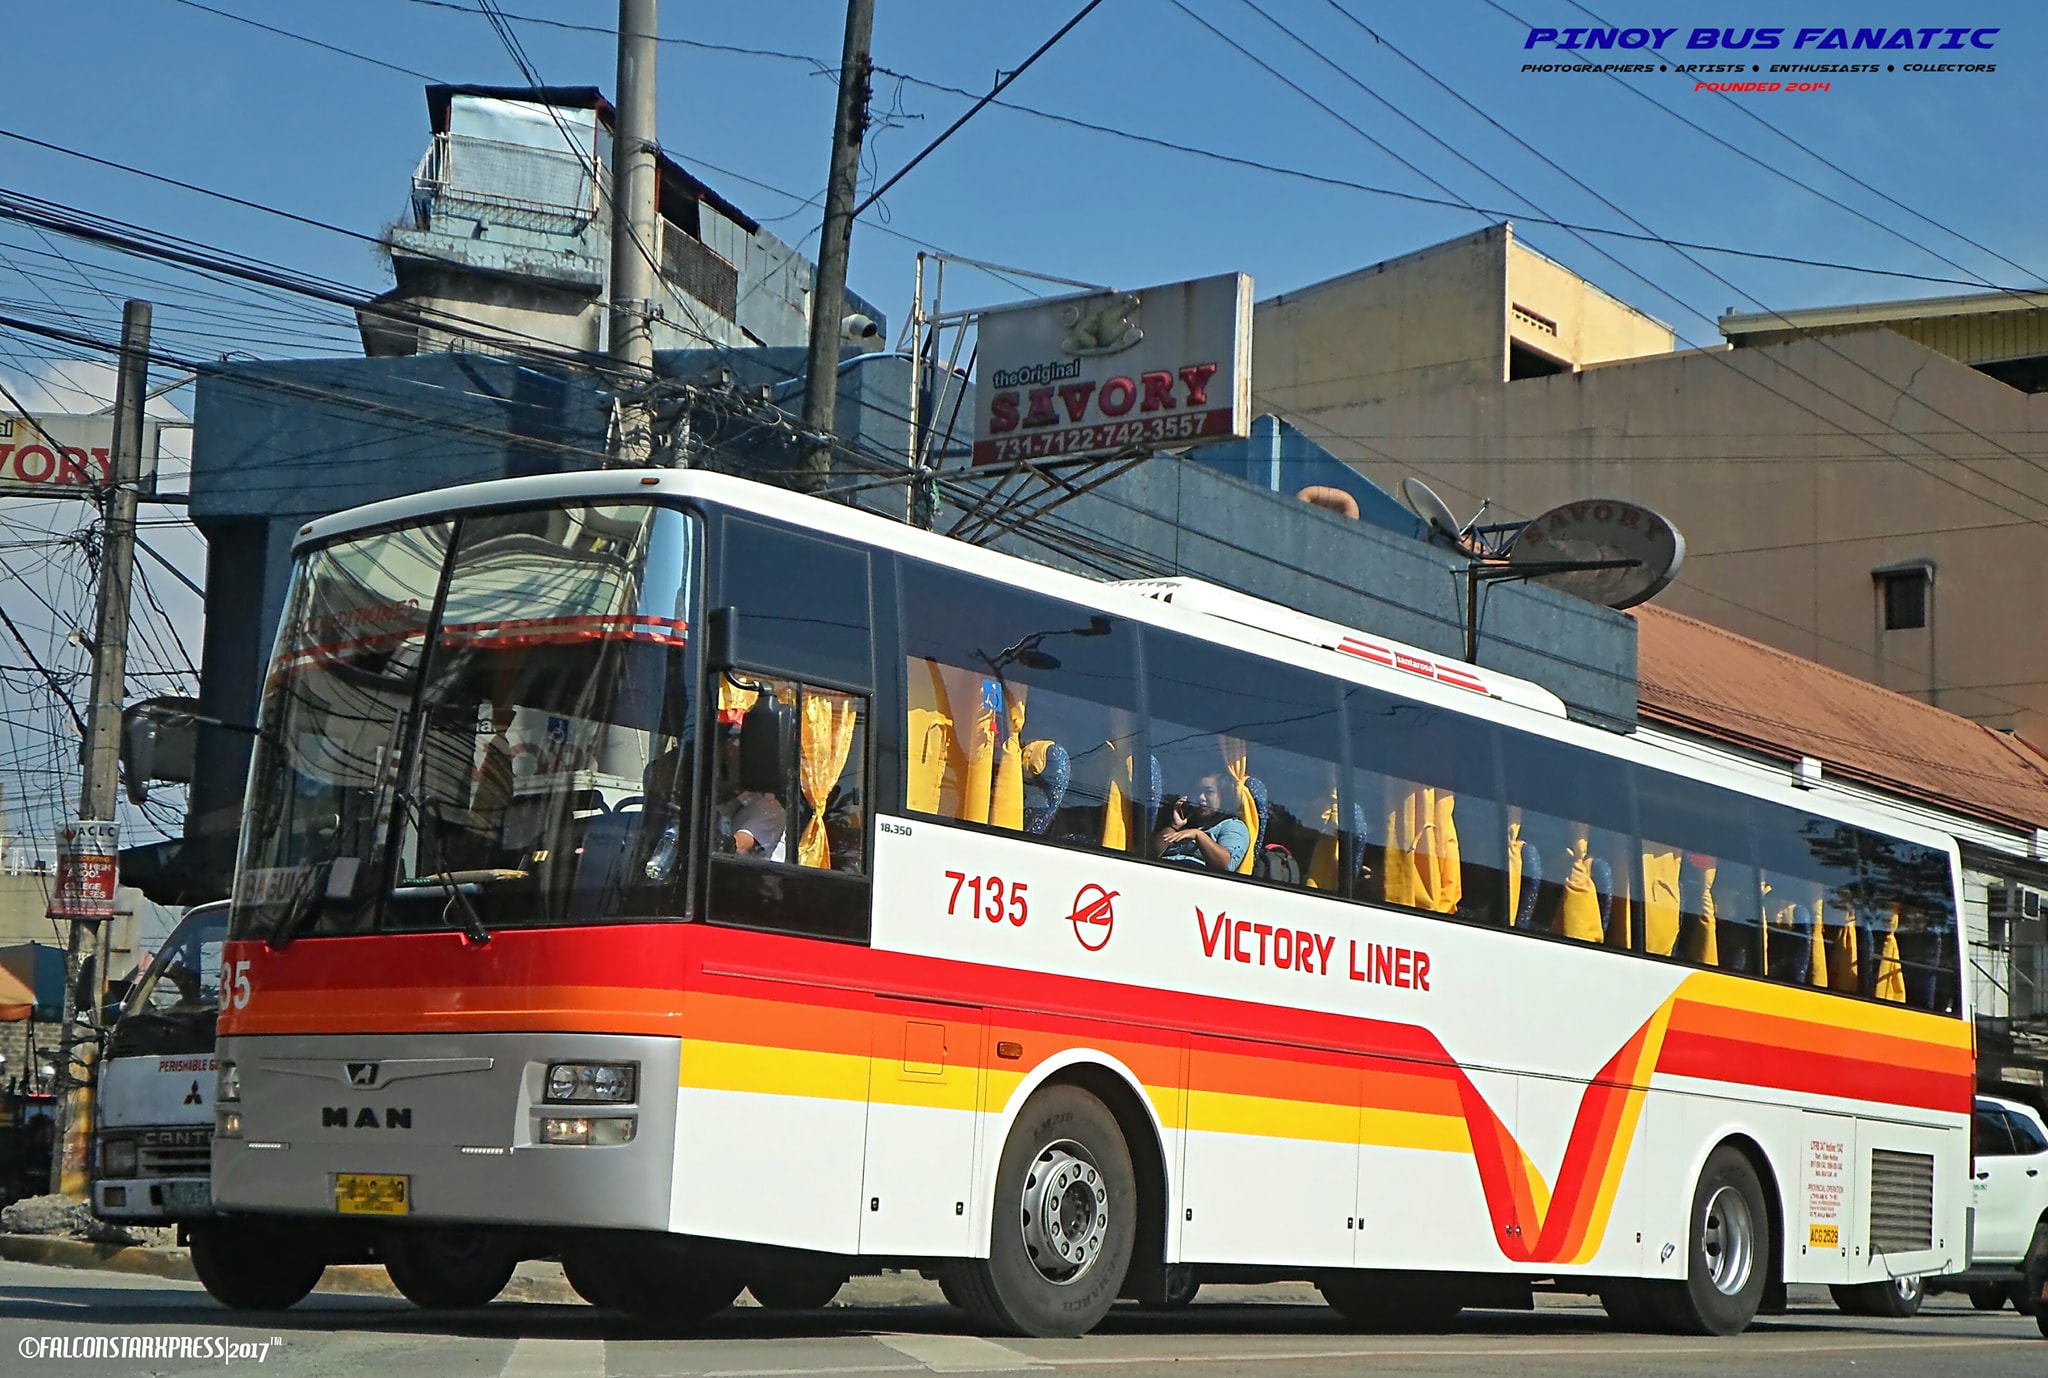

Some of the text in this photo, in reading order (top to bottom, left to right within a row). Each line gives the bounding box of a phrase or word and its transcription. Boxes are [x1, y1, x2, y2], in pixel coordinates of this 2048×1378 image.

[989, 363, 1217, 435] SAVORY
[78, 826, 115, 837] ACLC
[880, 822, 913, 837] 18.350
[945, 870, 1028, 928] 7135
[1195, 905, 1431, 992] VICTORY LINER
[159, 1059, 207, 1072] PERISHABLE
[322, 1106, 412, 1129] MAN
